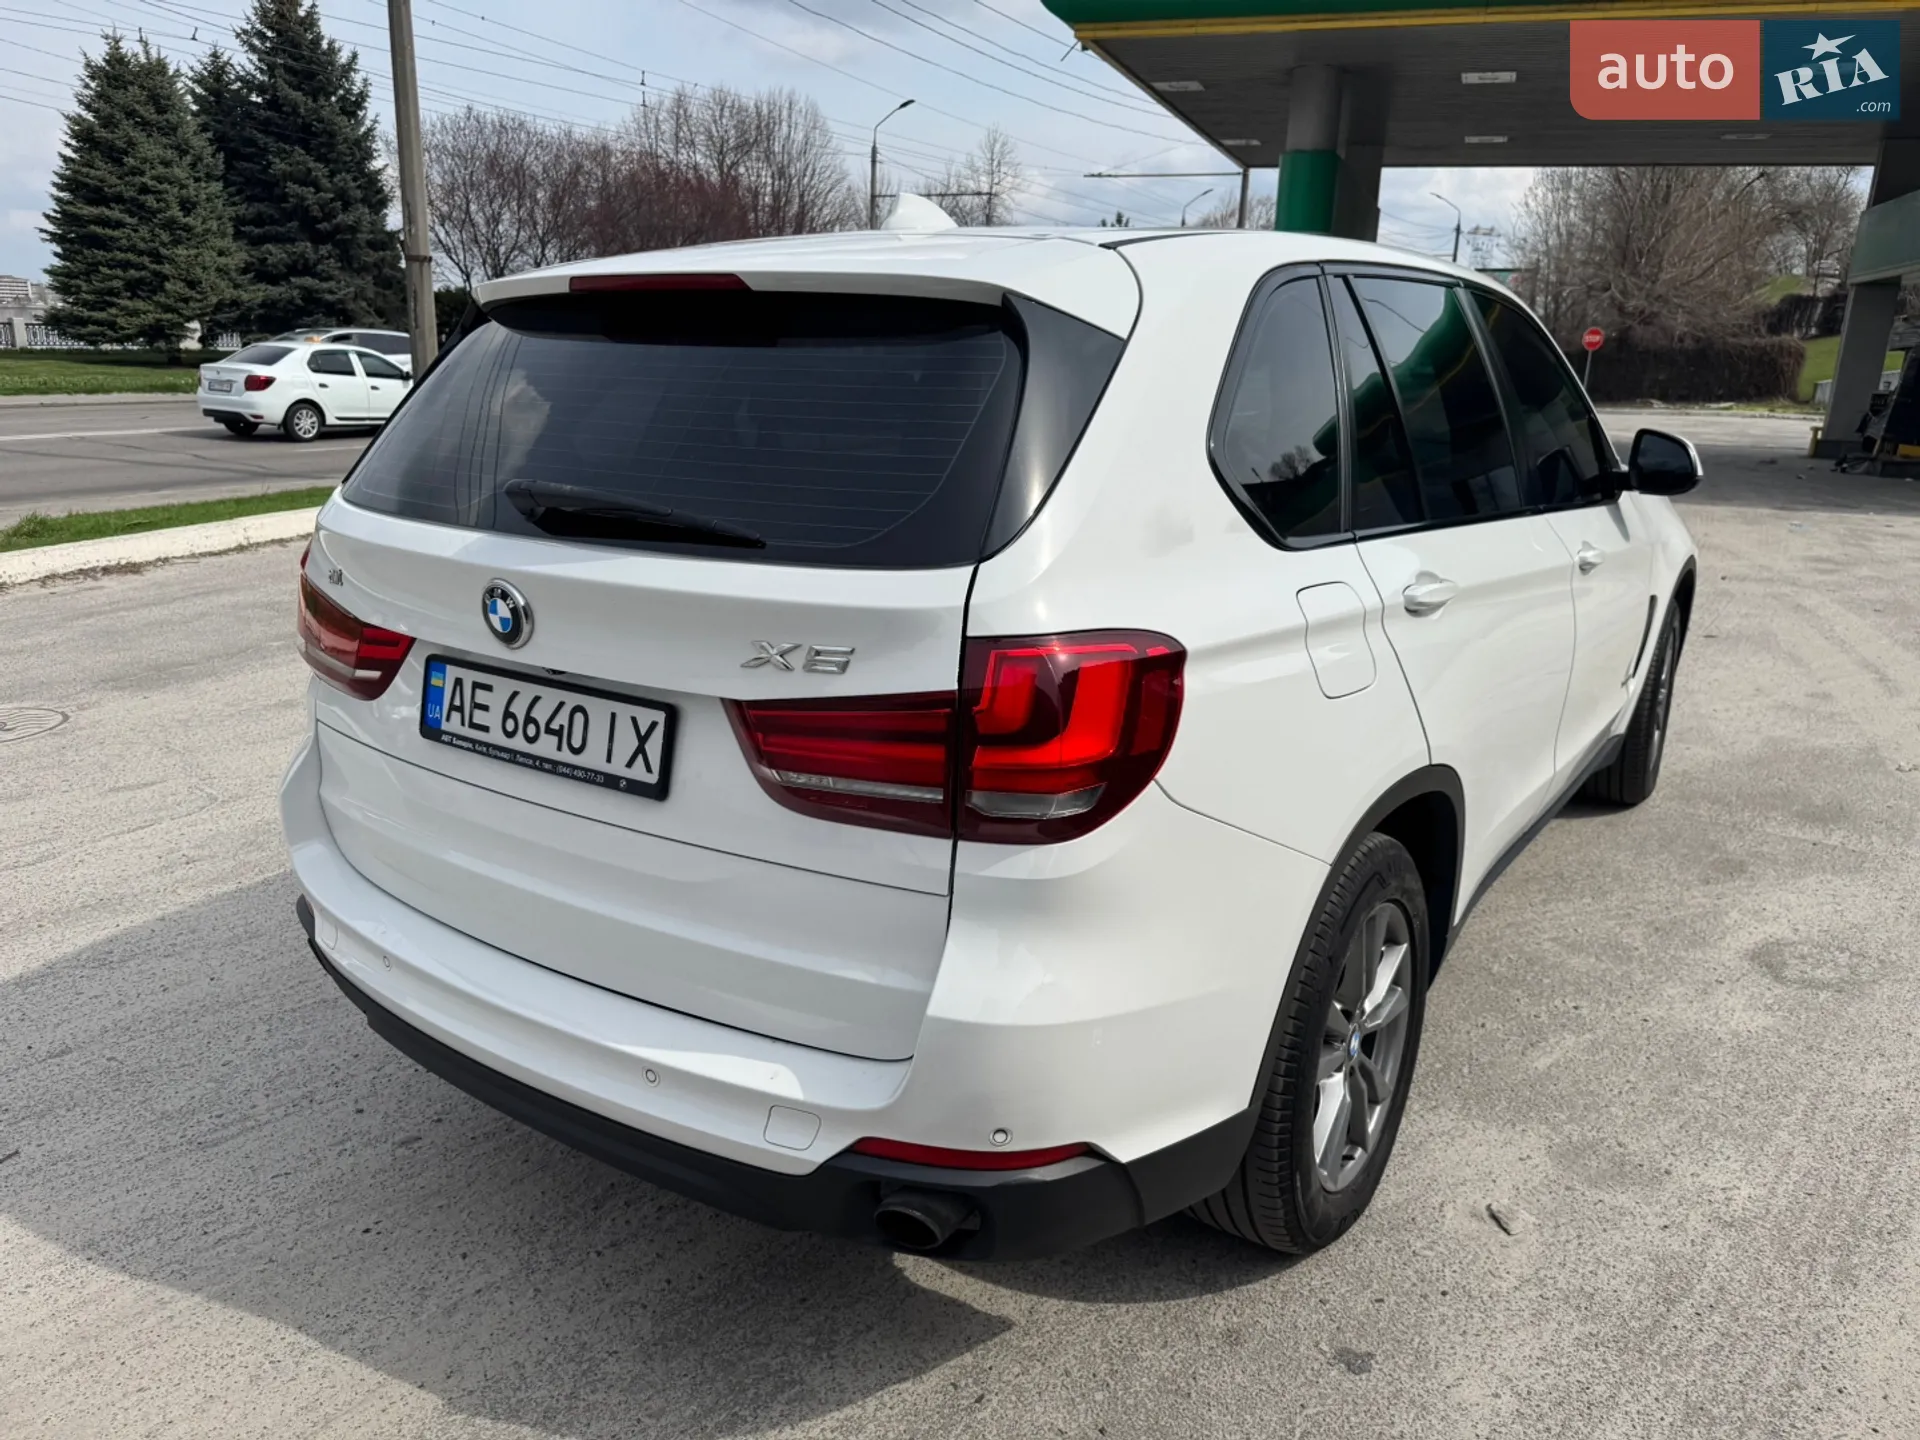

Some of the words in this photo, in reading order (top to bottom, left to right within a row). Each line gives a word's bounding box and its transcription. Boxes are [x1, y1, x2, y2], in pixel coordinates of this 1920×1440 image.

[740, 640, 855, 674] X5
[427, 703, 441, 720] UA
[445, 677, 494, 734] AE
[501, 691, 590, 756] 6640
[605, 711, 659, 774] IX
